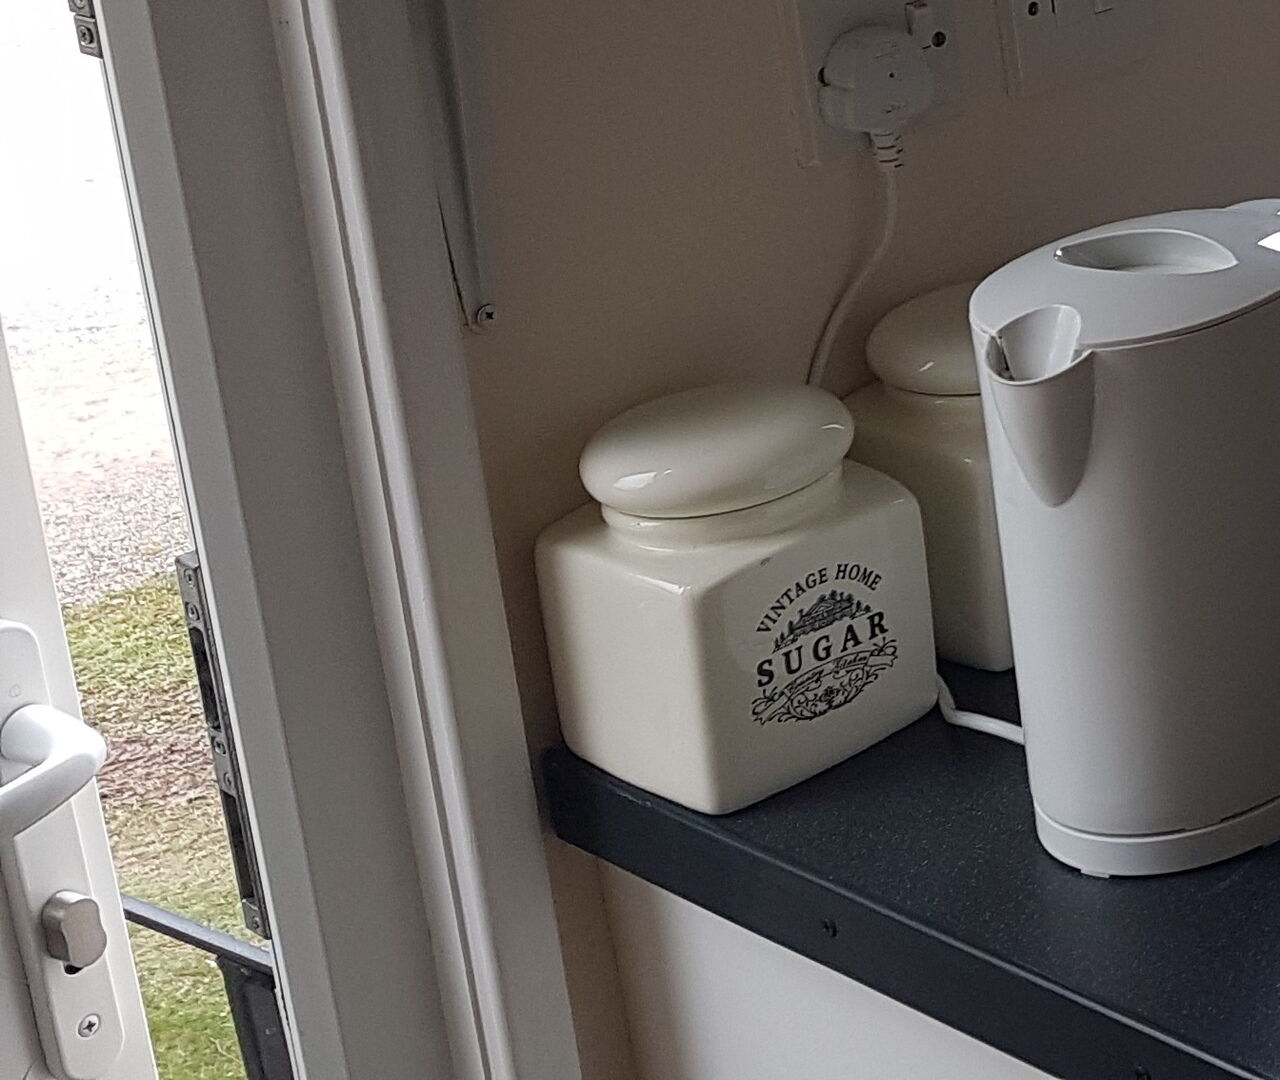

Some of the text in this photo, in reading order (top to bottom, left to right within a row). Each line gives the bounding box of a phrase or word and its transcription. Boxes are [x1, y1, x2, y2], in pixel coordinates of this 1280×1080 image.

[756, 563, 882, 633] VINTAGE HOME
[756, 611, 889, 688] SUGAR
